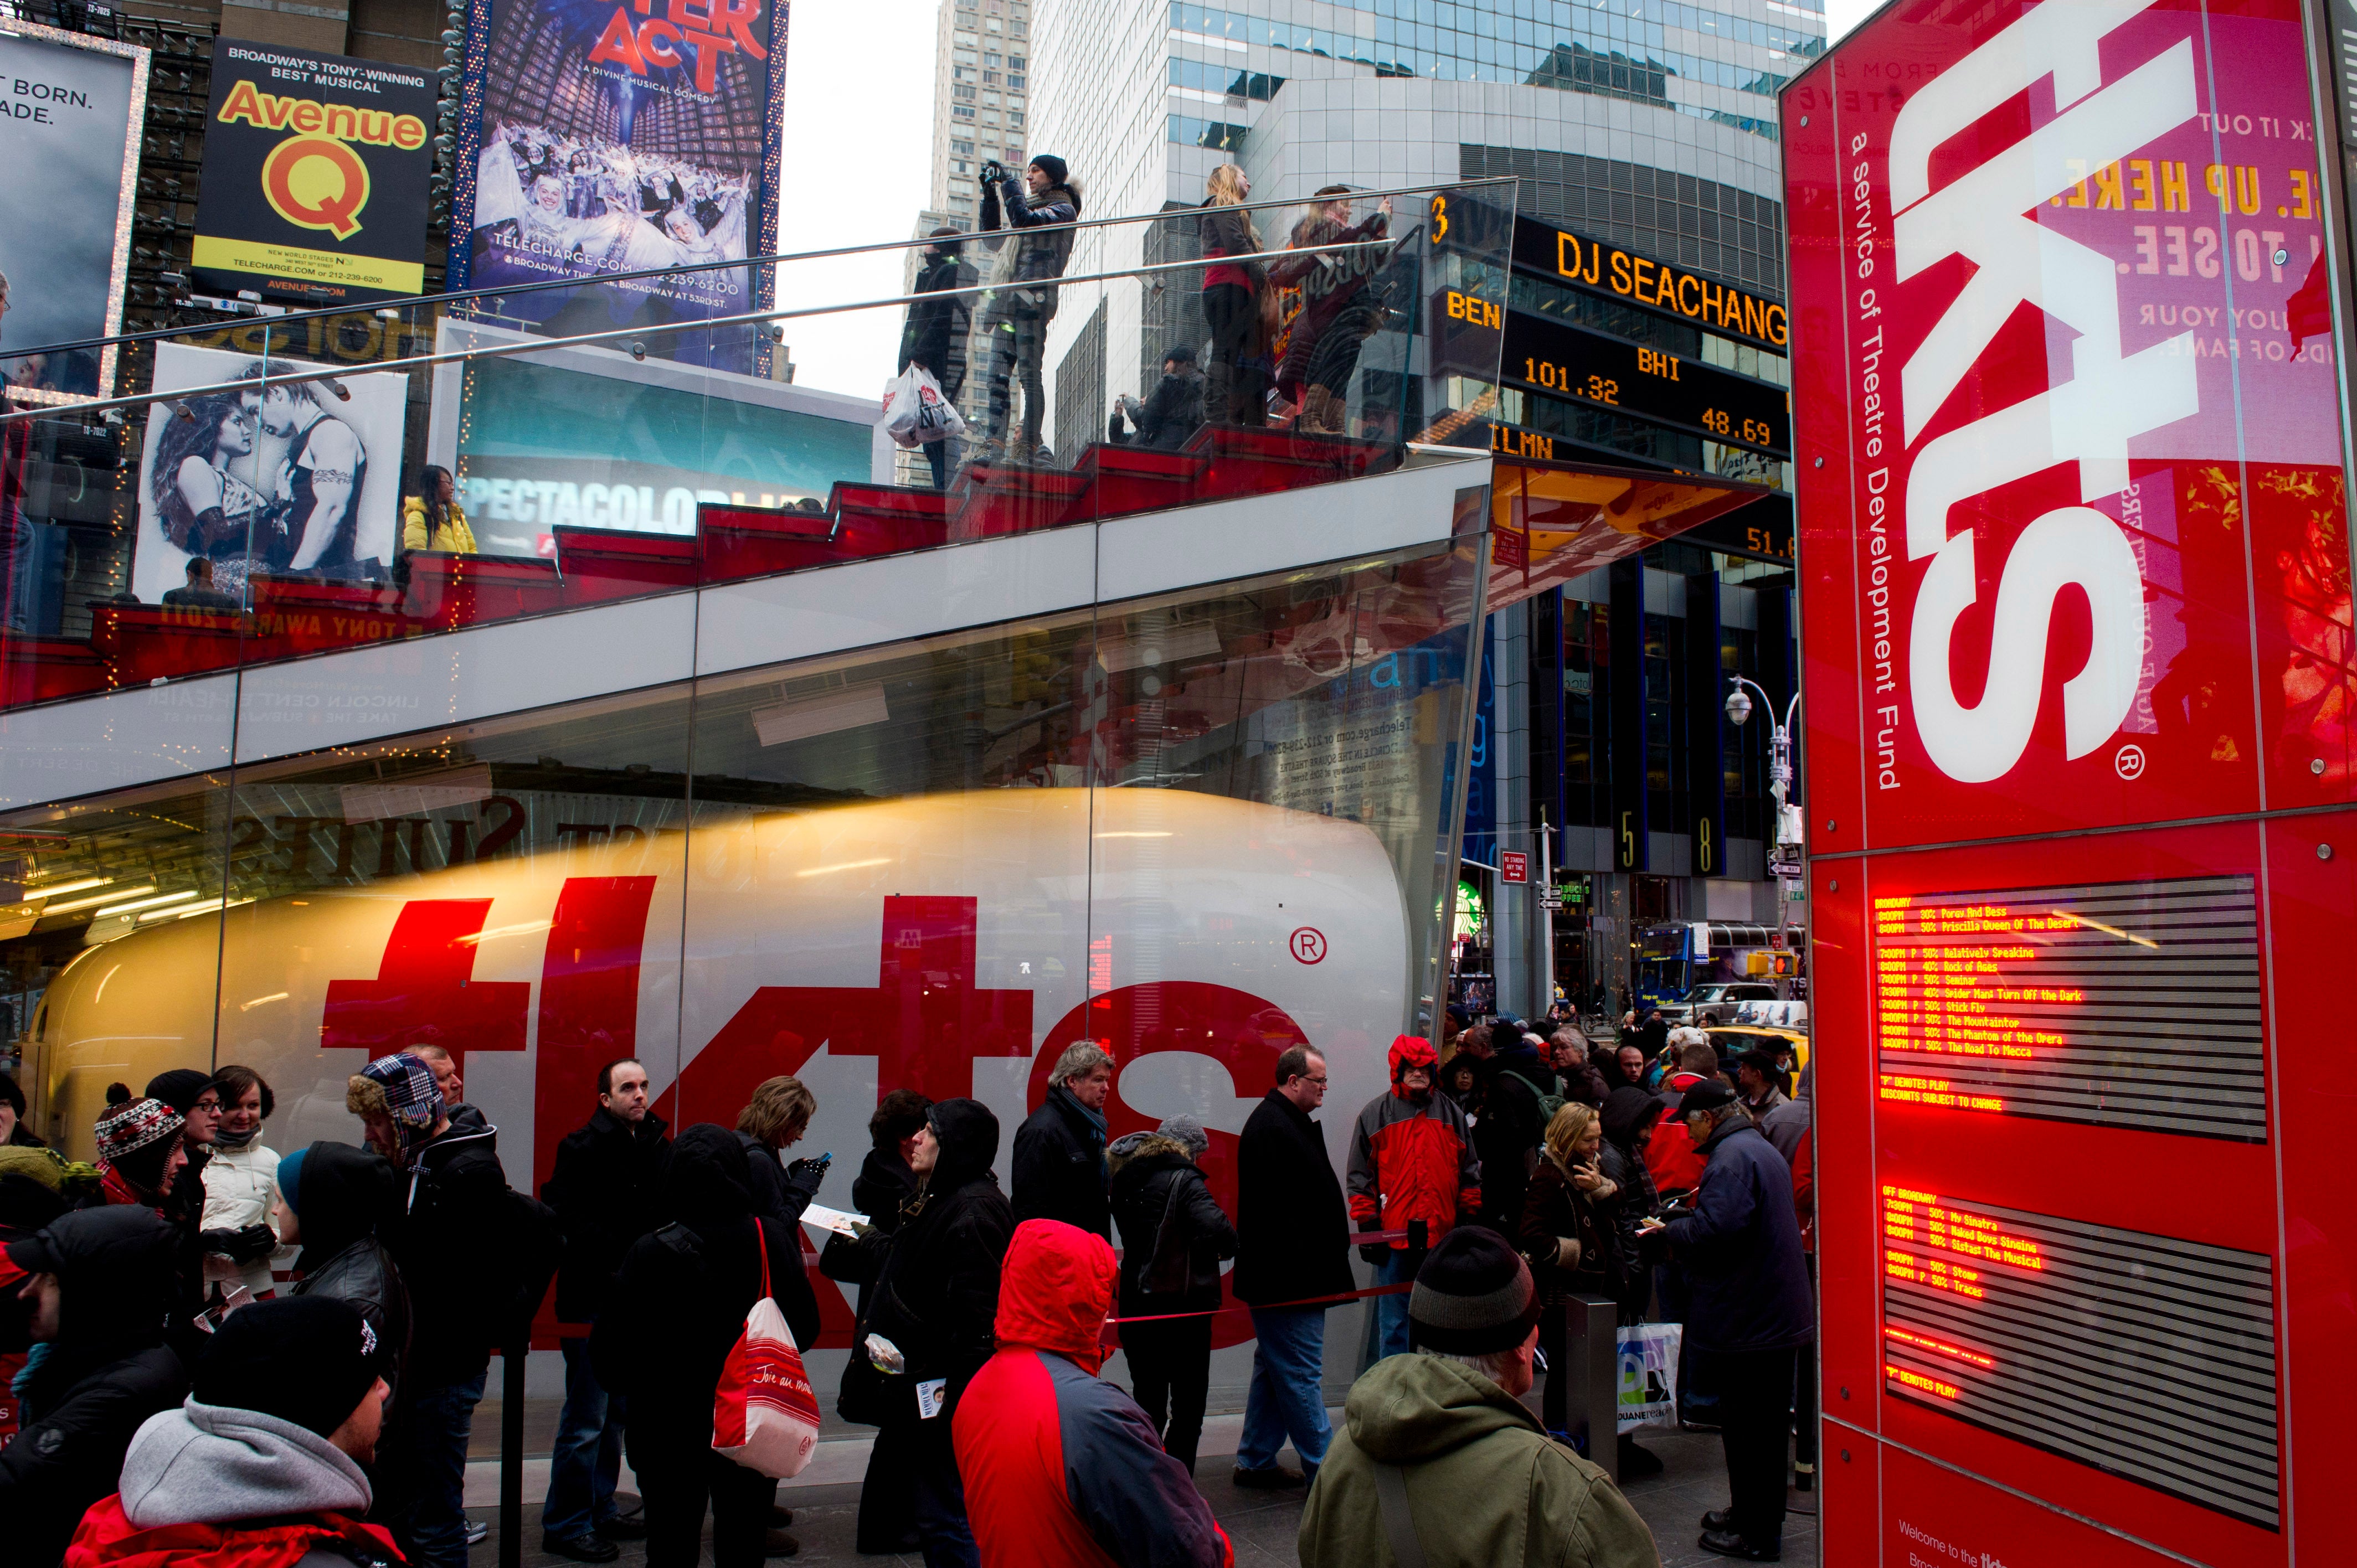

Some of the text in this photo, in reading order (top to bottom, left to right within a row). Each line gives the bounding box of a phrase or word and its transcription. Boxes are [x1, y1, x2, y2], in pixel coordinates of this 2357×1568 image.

[88, 3, 111, 17] TS-7025
[228, 47, 318, 71] BROADWAY'S
[588, 6, 738, 94] ACT
[14, 79, 92, 109] BORN.
[271, 67, 381, 93] BEST MUSICAL
[593, 66, 626, 82] DIVINE
[630, 77, 671, 95] MUSICAL
[674, 89, 717, 105] COMEDY
[219, 81, 426, 149] Avenue
[262, 134, 370, 241] Q
[1432, 196, 1448, 244] 3
[234, 259, 315, 275] TELECHARGE.COM
[329, 271, 383, 283] 212-239-6200
[309, 254, 334, 262] STAGES
[494, 233, 632, 272] TELECHARGE.COM
[514, 257, 572, 277] BROADWAY
[619, 281, 673, 298] BROADWAY
[675, 291, 687, 300] AT
[689, 293, 712, 306] 53RD
[713, 300, 728, 308] ST.
[1557, 231, 1787, 345] DJ SEACHANG
[1448, 291, 1500, 329] BEN
[1638, 347, 1680, 381] BHI
[1525, 357, 1771, 446] 101.32 48.69
[1852, 132, 1901, 791] a service of Theatre Development Fund
[1623, 811, 1633, 868] 5
[1700, 817, 1711, 873] 8
[1899, 1519, 1946, 1552] Welcome
[1948, 1543, 1958, 1558] to
[1961, 1549, 1978, 1567] the
